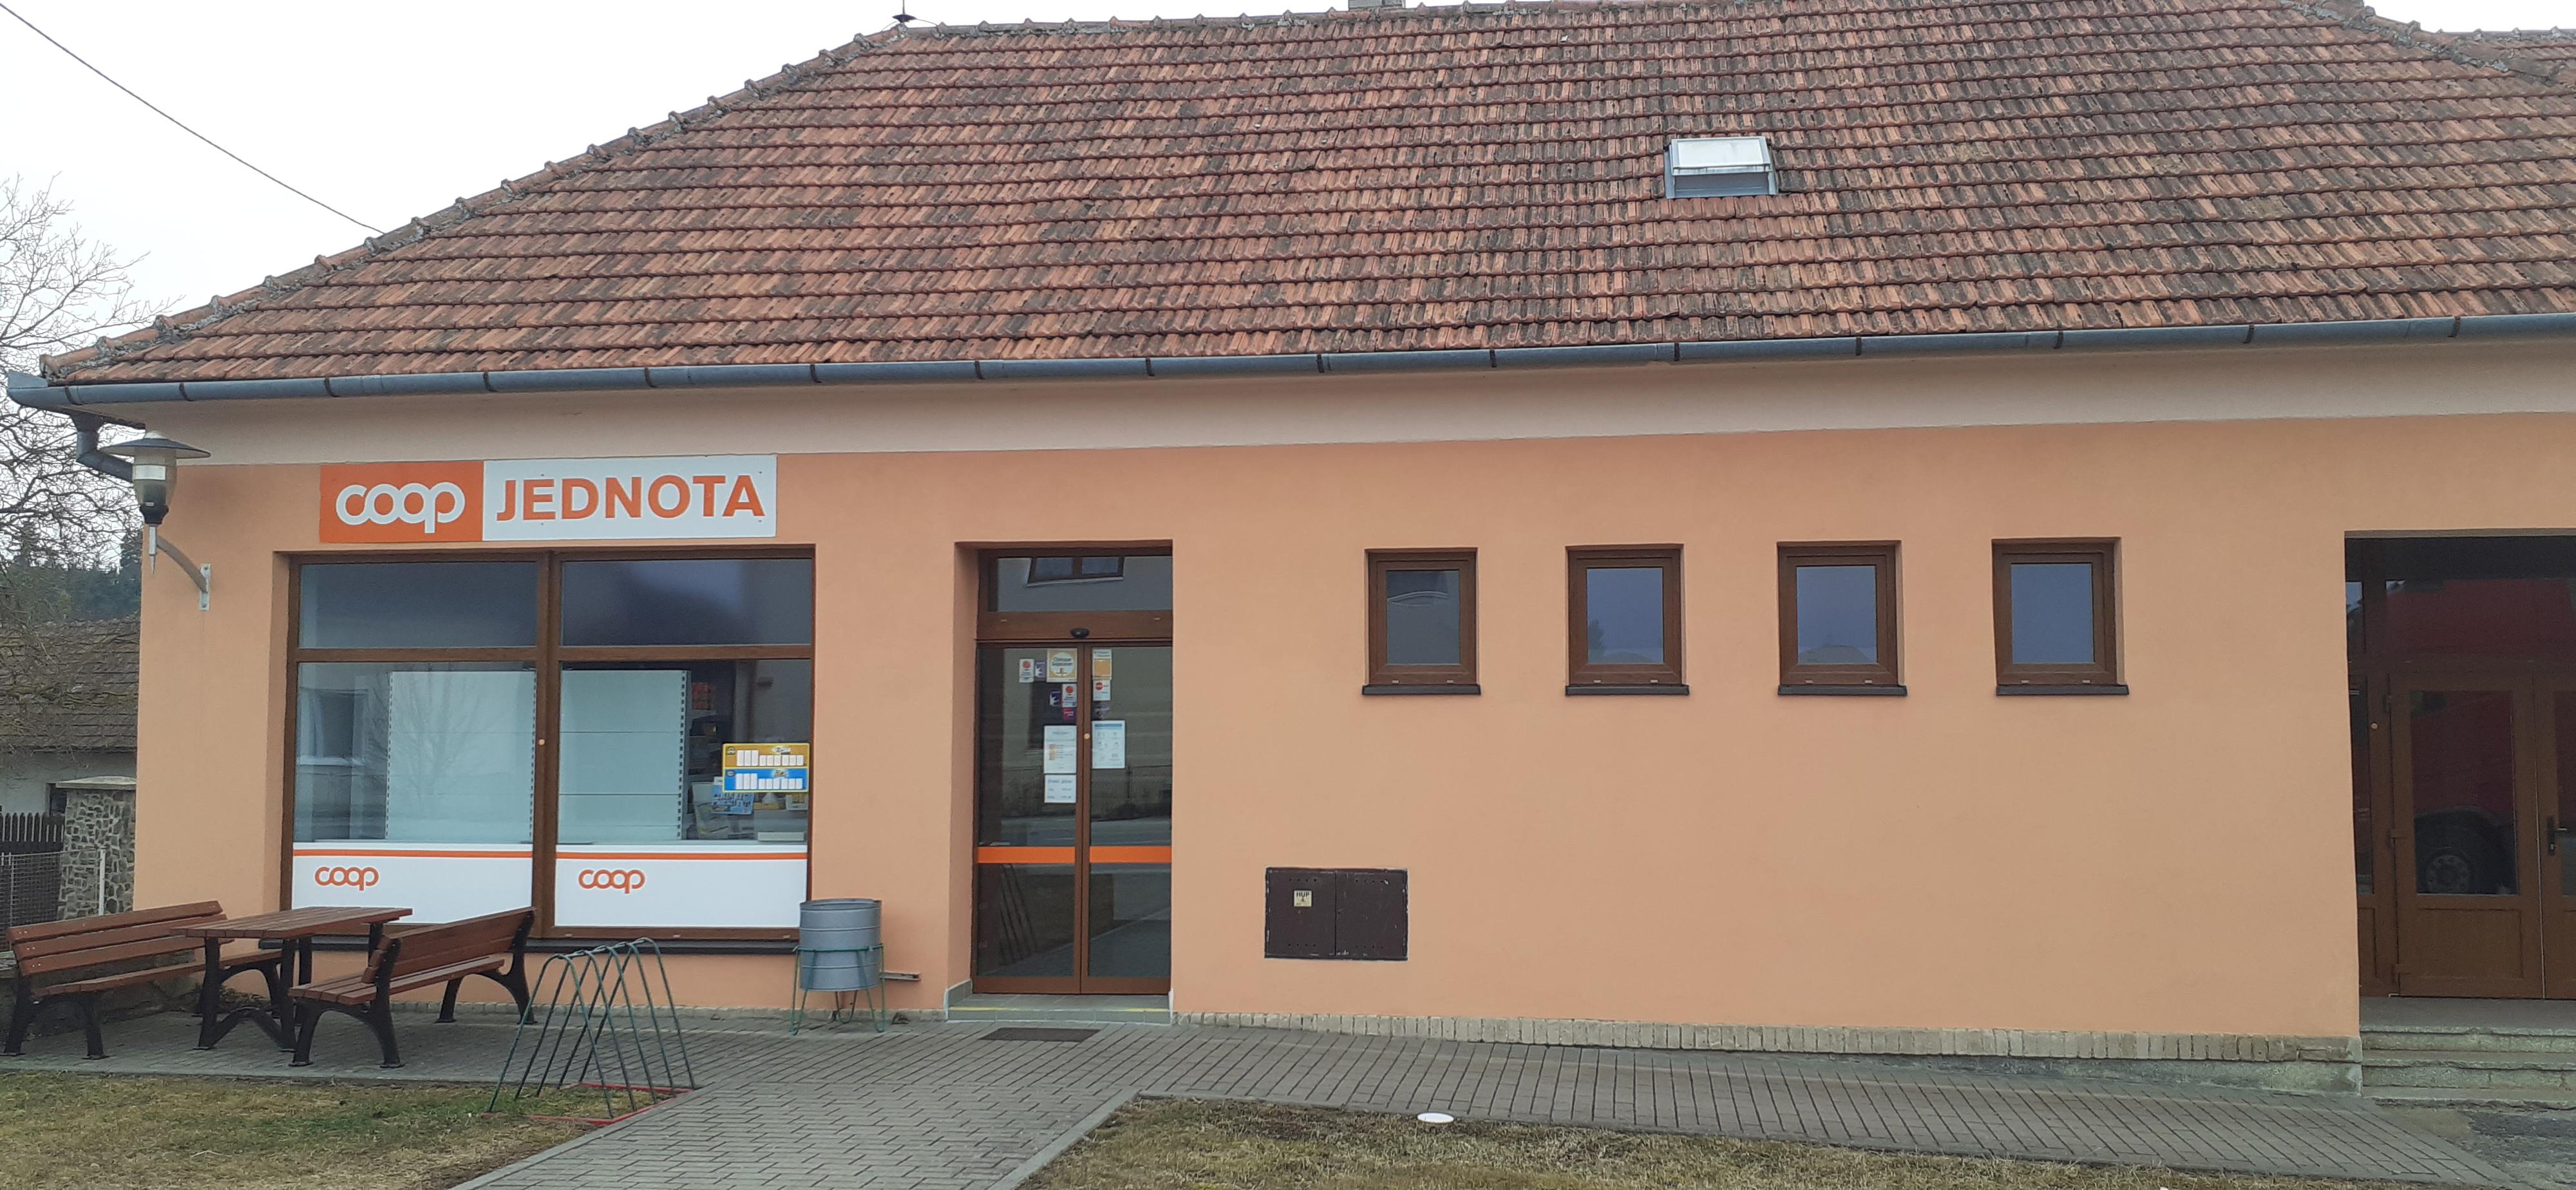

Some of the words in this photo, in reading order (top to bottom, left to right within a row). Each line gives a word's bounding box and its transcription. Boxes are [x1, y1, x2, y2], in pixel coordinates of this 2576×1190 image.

[336, 482, 466, 533] coop
[497, 475, 766, 521] JEDNOTA
[315, 866, 379, 891] coop
[578, 869, 645, 894] coop
